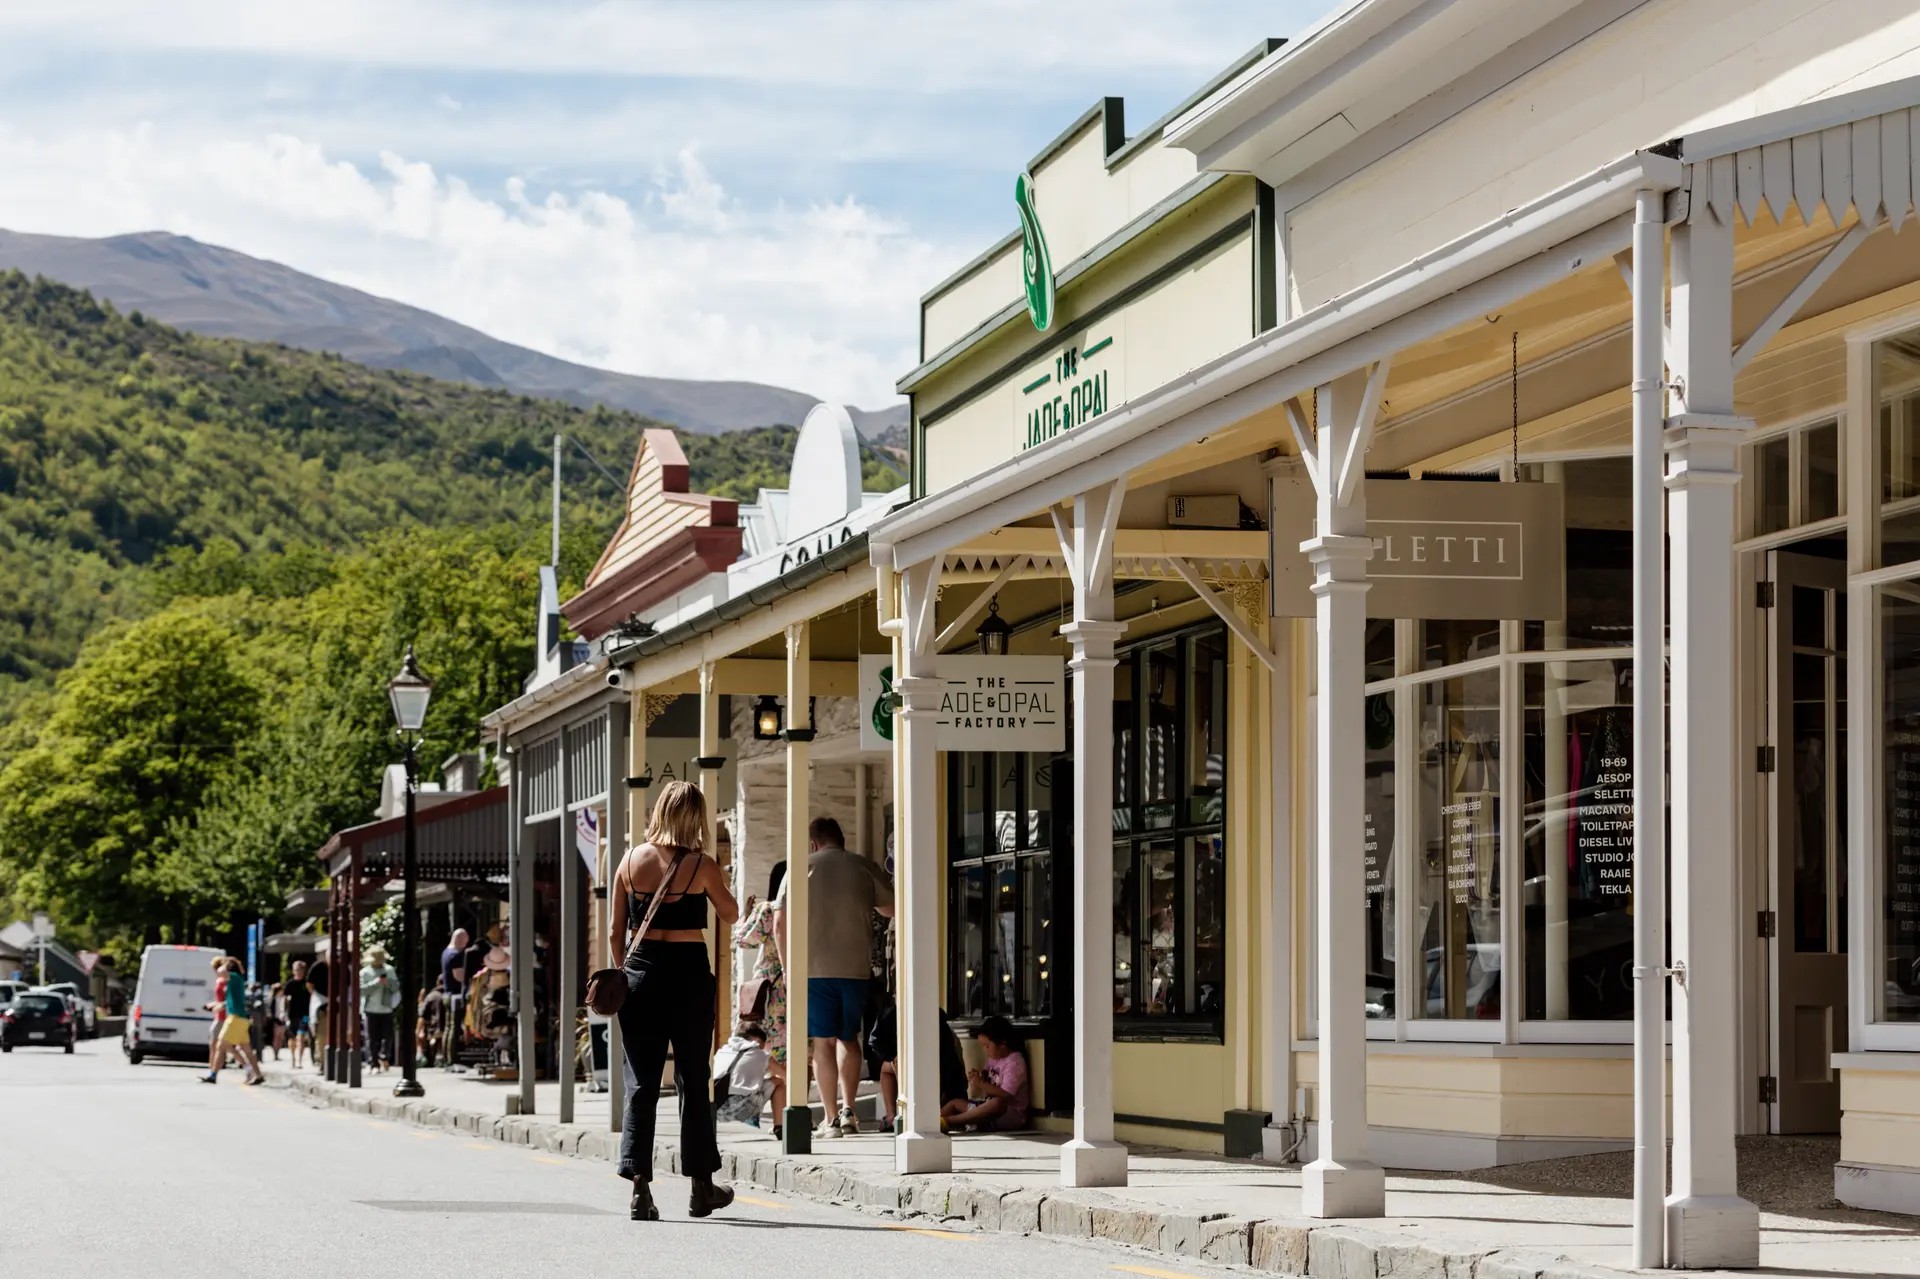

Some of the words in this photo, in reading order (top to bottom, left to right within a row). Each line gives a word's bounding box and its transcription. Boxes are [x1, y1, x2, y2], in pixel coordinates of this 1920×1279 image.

[1055, 347, 1077, 384] THE
[976, 677, 1006, 688] THE
[955, 717, 1026, 728] FACTORY
[1596, 773, 1632, 783] AESOP
[1579, 837, 1614, 848] DIESEL
[1585, 852, 1624, 863] STUDIO
[1600, 868, 1631, 878] RAAIE
[1600, 884, 1632, 894] TEKLA
